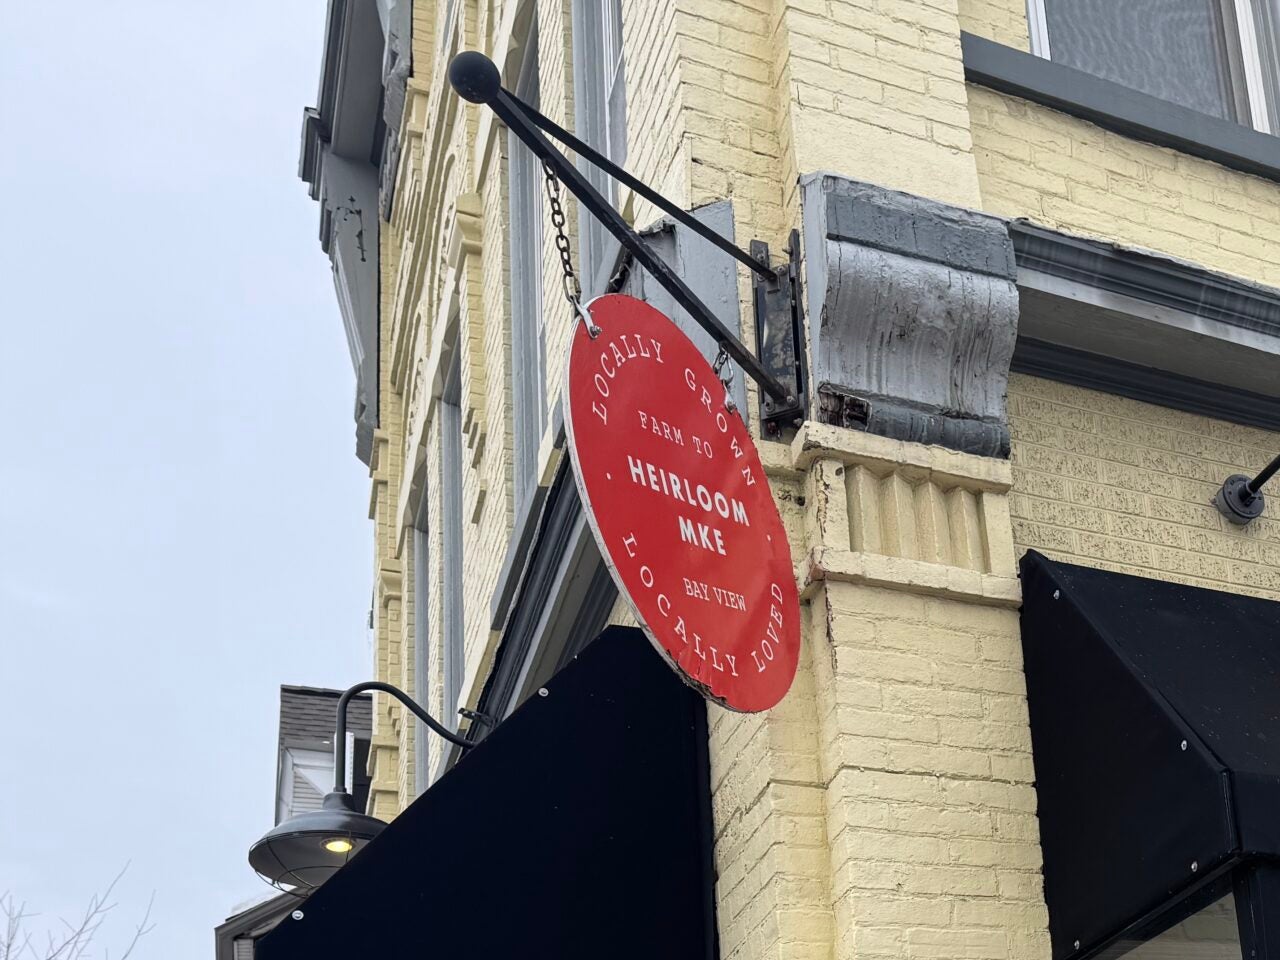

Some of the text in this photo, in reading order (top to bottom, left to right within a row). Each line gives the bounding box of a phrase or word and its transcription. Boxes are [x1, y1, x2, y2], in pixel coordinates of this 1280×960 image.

[593, 334, 756, 486] LOCALLY GROWN
[638, 410, 714, 459] FARM TO
[628, 456, 749, 527] HEIRLOOM
[678, 515, 727, 556] MKE
[623, 532, 784, 677] LOCALLY LOVED
[683, 577, 747, 611] BAY VIEW
